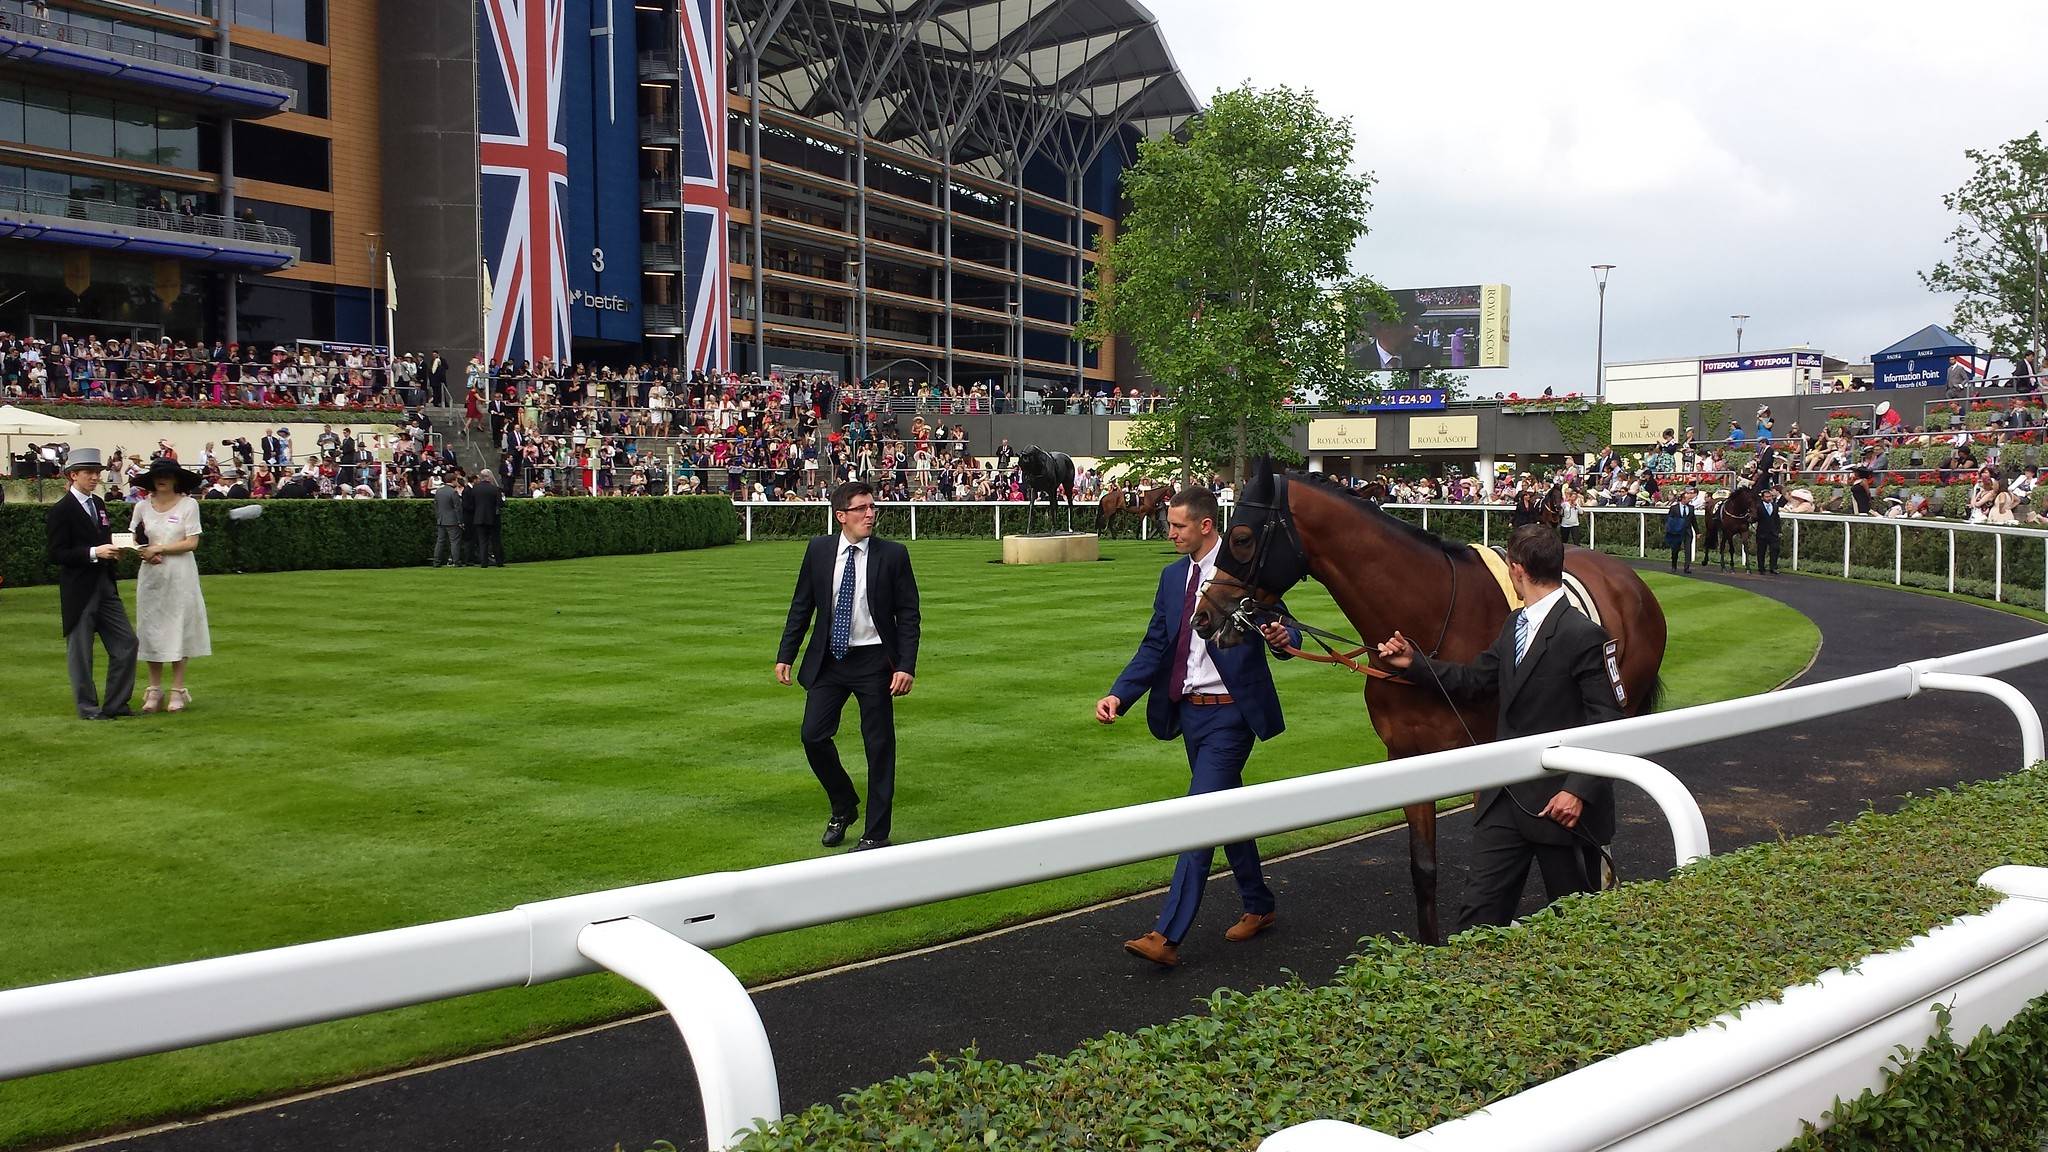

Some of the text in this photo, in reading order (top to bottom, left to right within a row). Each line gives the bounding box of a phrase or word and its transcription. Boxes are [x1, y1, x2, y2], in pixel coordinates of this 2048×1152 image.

[592, 248, 605, 272] 3
[584, 290, 630, 312] betfai
[1486, 289, 1496, 362] ROYAL ASCOT
[1704, 357, 1791, 370] TOTEPOOL TOTEPOOL
[1884, 370, 1940, 382] Information Point
[1398, 395, 1432, 405] £24.90
[1620, 431, 1642, 439] ROYAL
